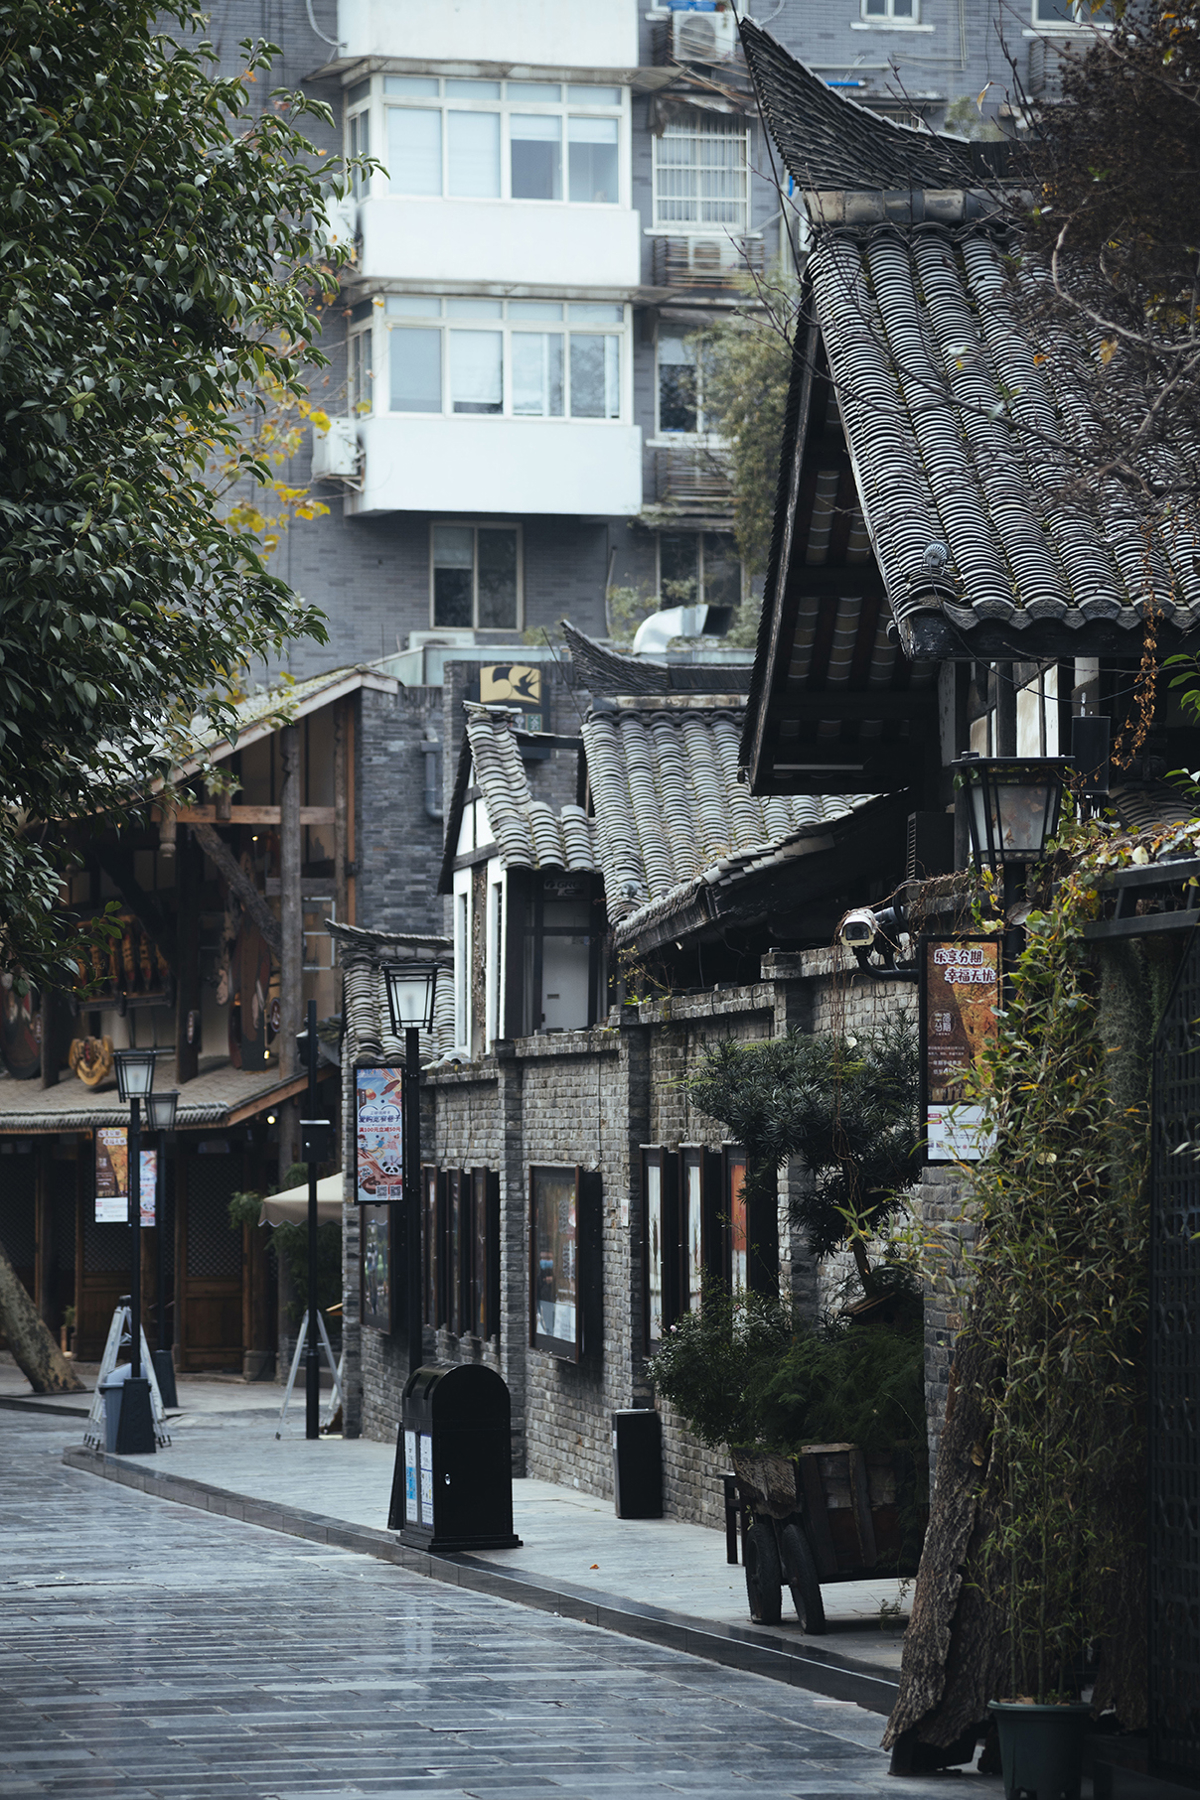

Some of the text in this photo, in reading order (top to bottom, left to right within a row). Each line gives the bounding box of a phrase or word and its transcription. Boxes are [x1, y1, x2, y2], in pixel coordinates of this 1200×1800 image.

[935, 949, 983, 964] 乐享分期
[946, 968, 996, 982] 幸福无忧
